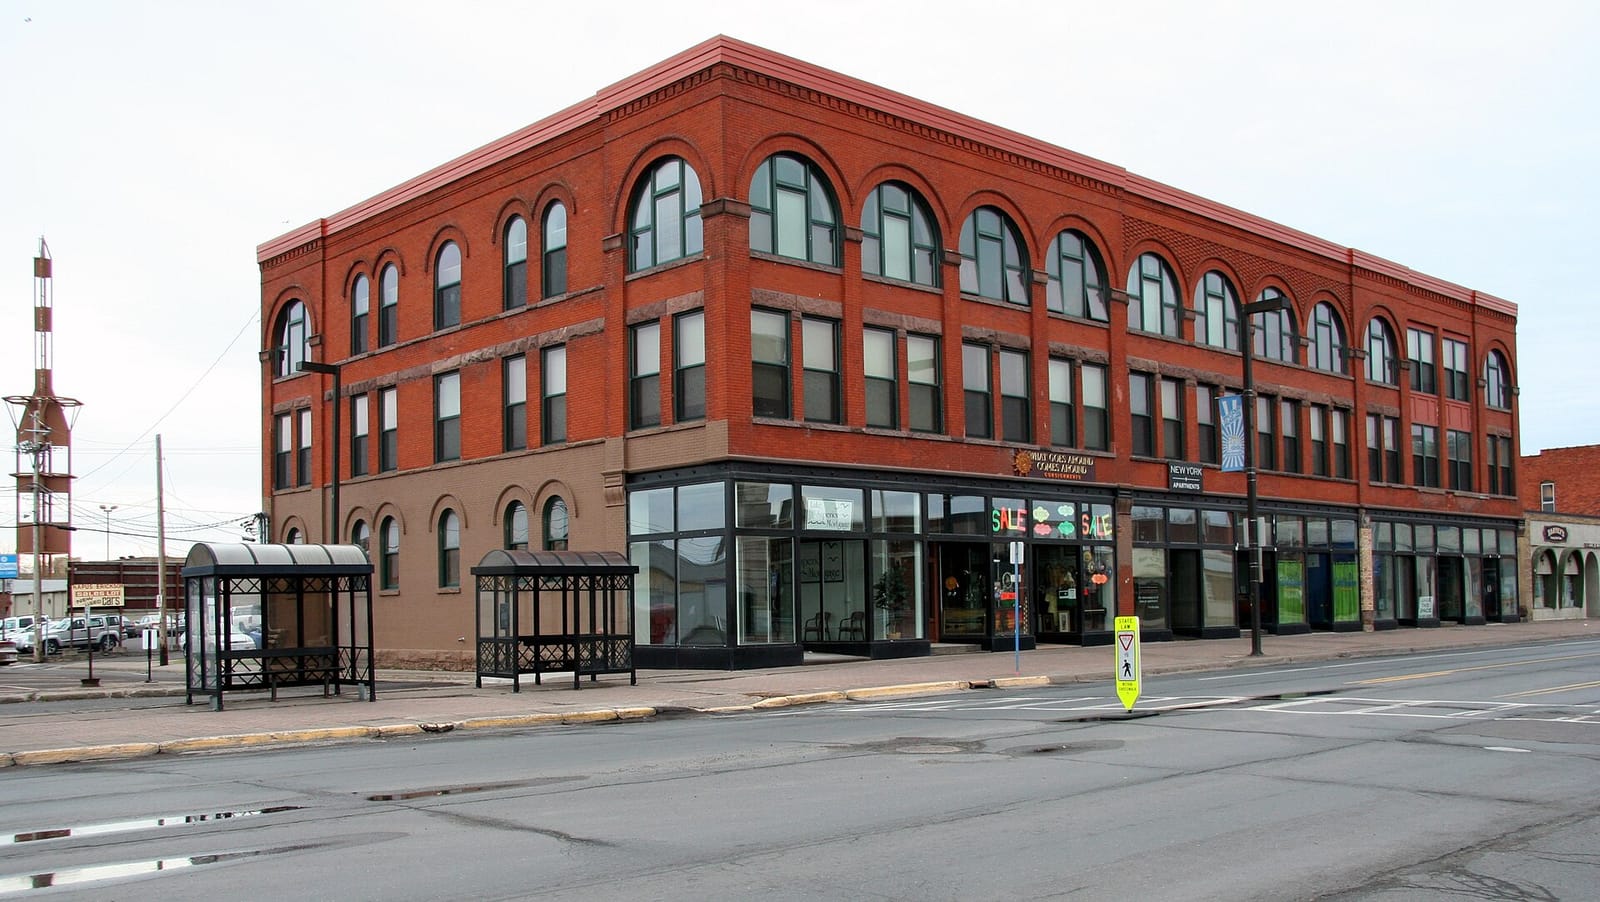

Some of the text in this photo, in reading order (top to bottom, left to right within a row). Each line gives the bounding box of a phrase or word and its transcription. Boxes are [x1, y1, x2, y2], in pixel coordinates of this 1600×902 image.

[1048, 453, 1066, 463] GOES
[1067, 455, 1094, 466] AROUND
[1036, 461, 1087, 474] COMES AROUND
[1170, 464, 1202, 476] NEW YORK
[1172, 481, 1200, 490] APARTMENTS
[992, 506, 1028, 532] SALE
[1081, 513, 1112, 537] SALE
